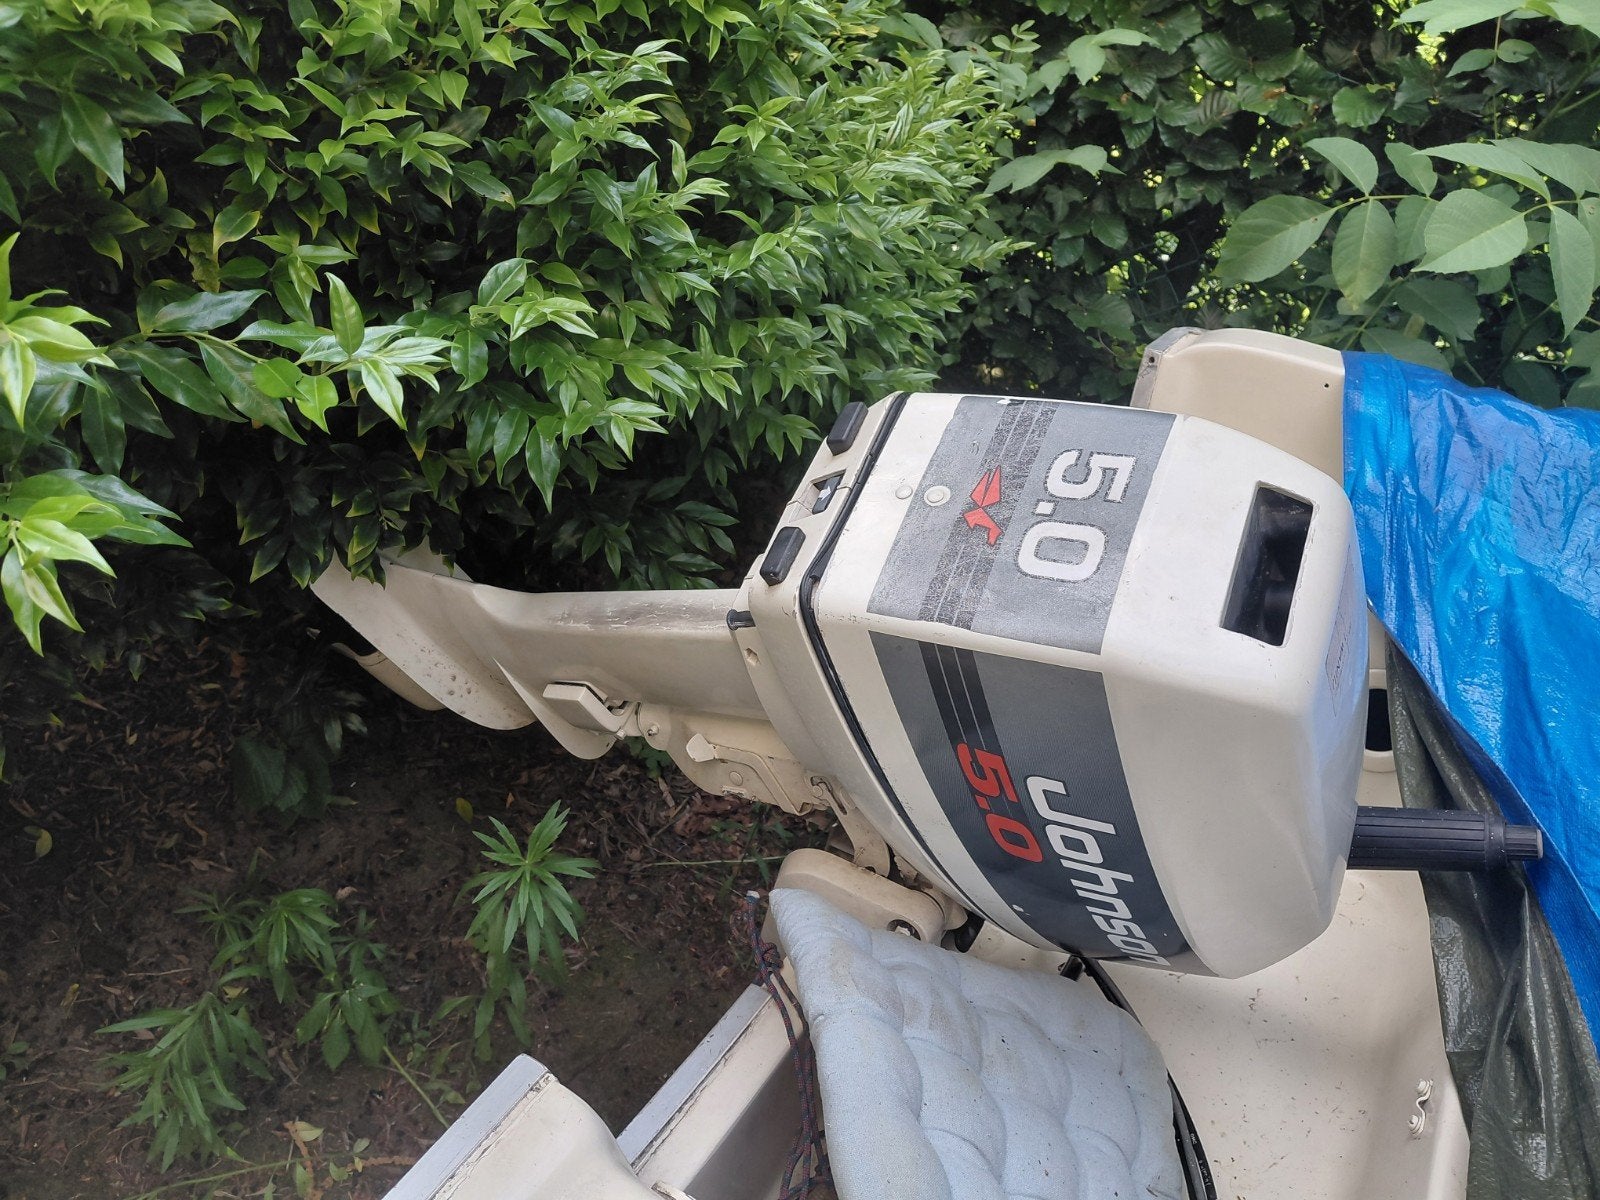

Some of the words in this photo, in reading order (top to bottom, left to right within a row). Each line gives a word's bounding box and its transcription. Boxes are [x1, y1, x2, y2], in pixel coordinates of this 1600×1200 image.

[1017, 448, 1137, 582] 5.0
[956, 742, 1044, 863] 5.0
[1025, 775, 1172, 966] Johnson
